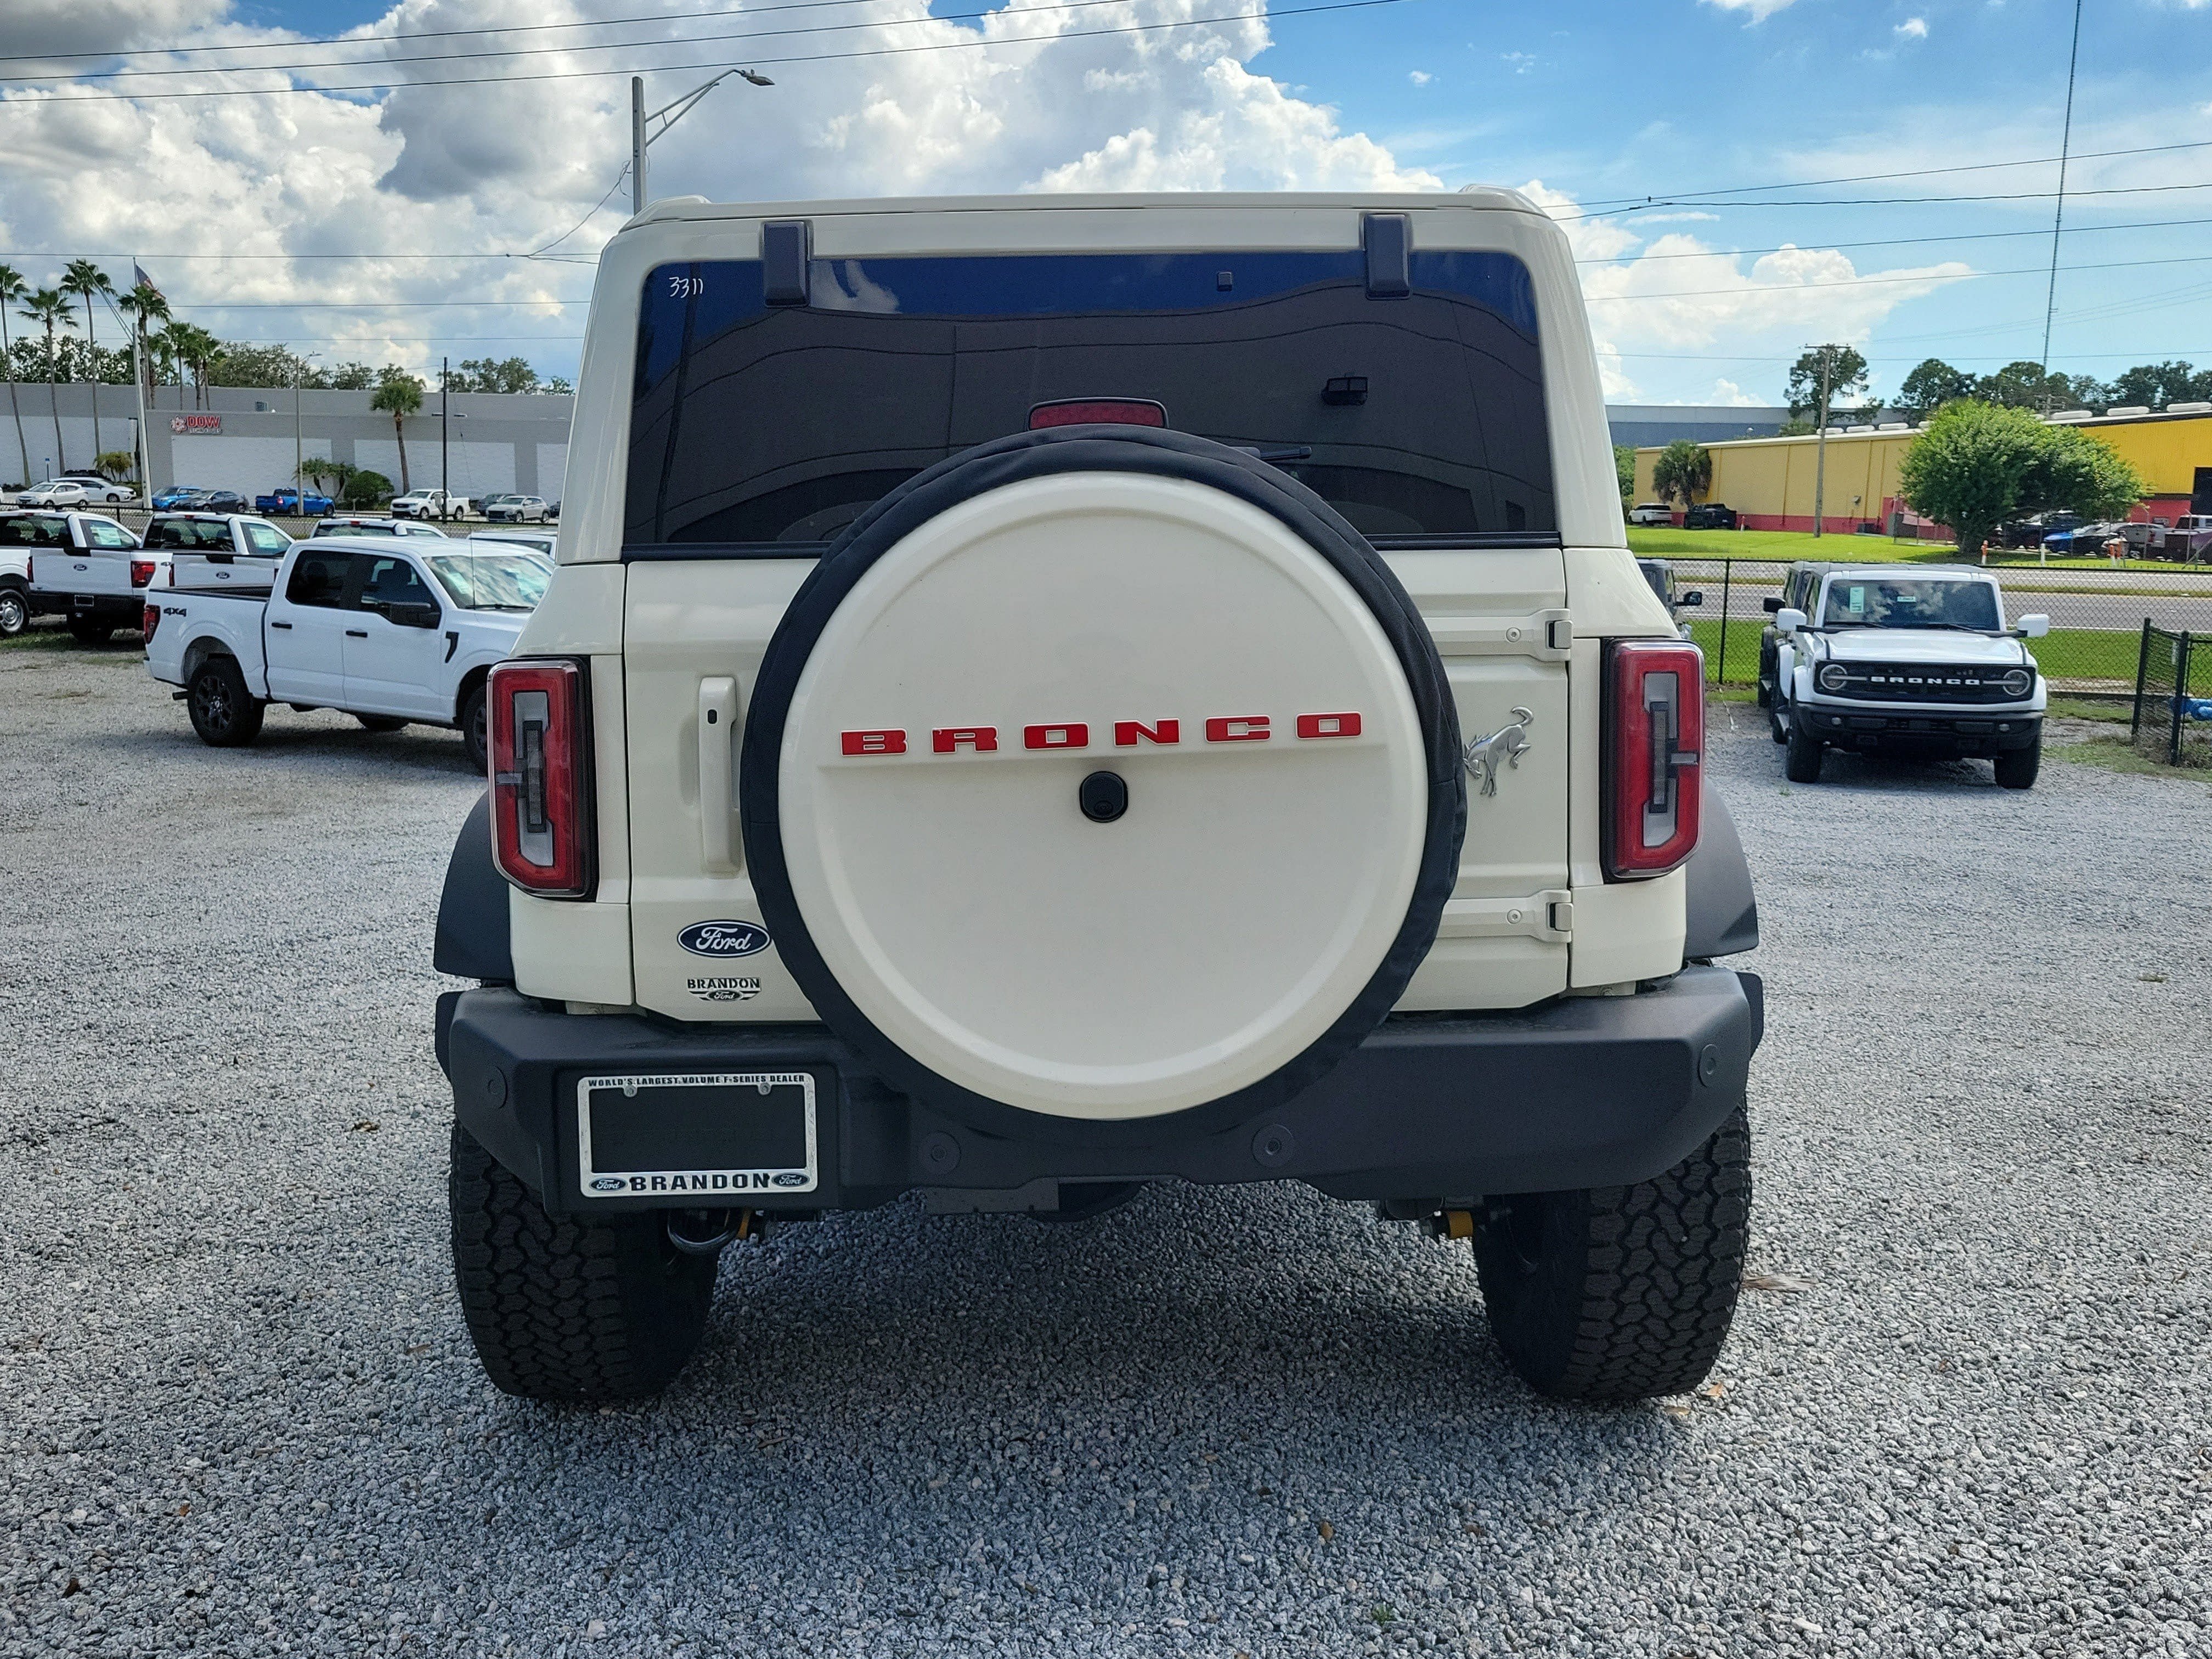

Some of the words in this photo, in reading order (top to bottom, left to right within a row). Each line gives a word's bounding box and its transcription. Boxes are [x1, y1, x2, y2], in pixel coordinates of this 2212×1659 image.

[669, 276, 703, 298] 3311
[187, 415, 220, 428] DOW
[1871, 676, 1980, 685] BRONCO
[840, 712, 1363, 756] BRONCO
[696, 927, 752, 950] Ford
[687, 978, 760, 989] BRANDON
[713, 991, 735, 1000] Ford
[589, 1078, 633, 1086] WORLD'S
[682, 1076, 720, 1084] VOLUME
[596, 1178, 620, 1189] Ford
[630, 1173, 769, 1191] BRANDON
[779, 1175, 803, 1185] Ford
